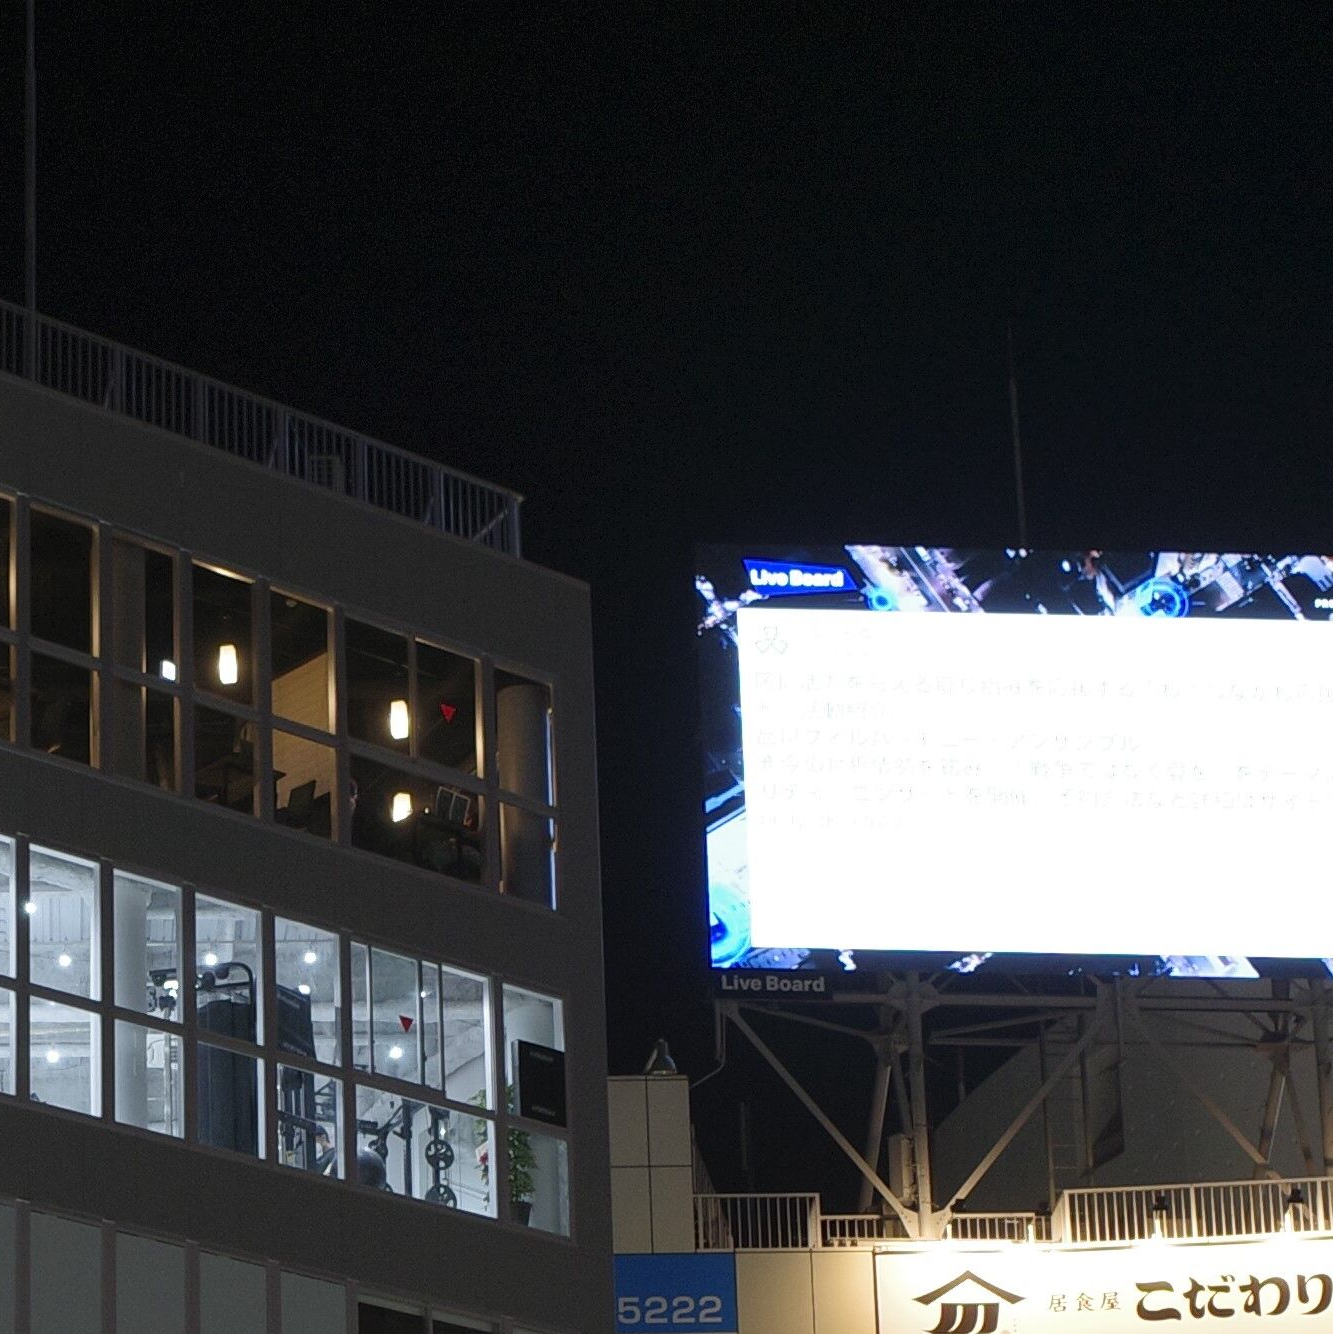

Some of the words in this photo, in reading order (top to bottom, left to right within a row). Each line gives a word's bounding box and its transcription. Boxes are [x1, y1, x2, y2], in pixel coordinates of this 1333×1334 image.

[750, 568, 787, 588] Live
[790, 568, 845, 588] Board
[722, 973, 762, 992] Live
[766, 975, 826, 994] Board
[1135, 1273, 1333, 1322] こだわり
[617, 1296, 723, 1324] 5222
